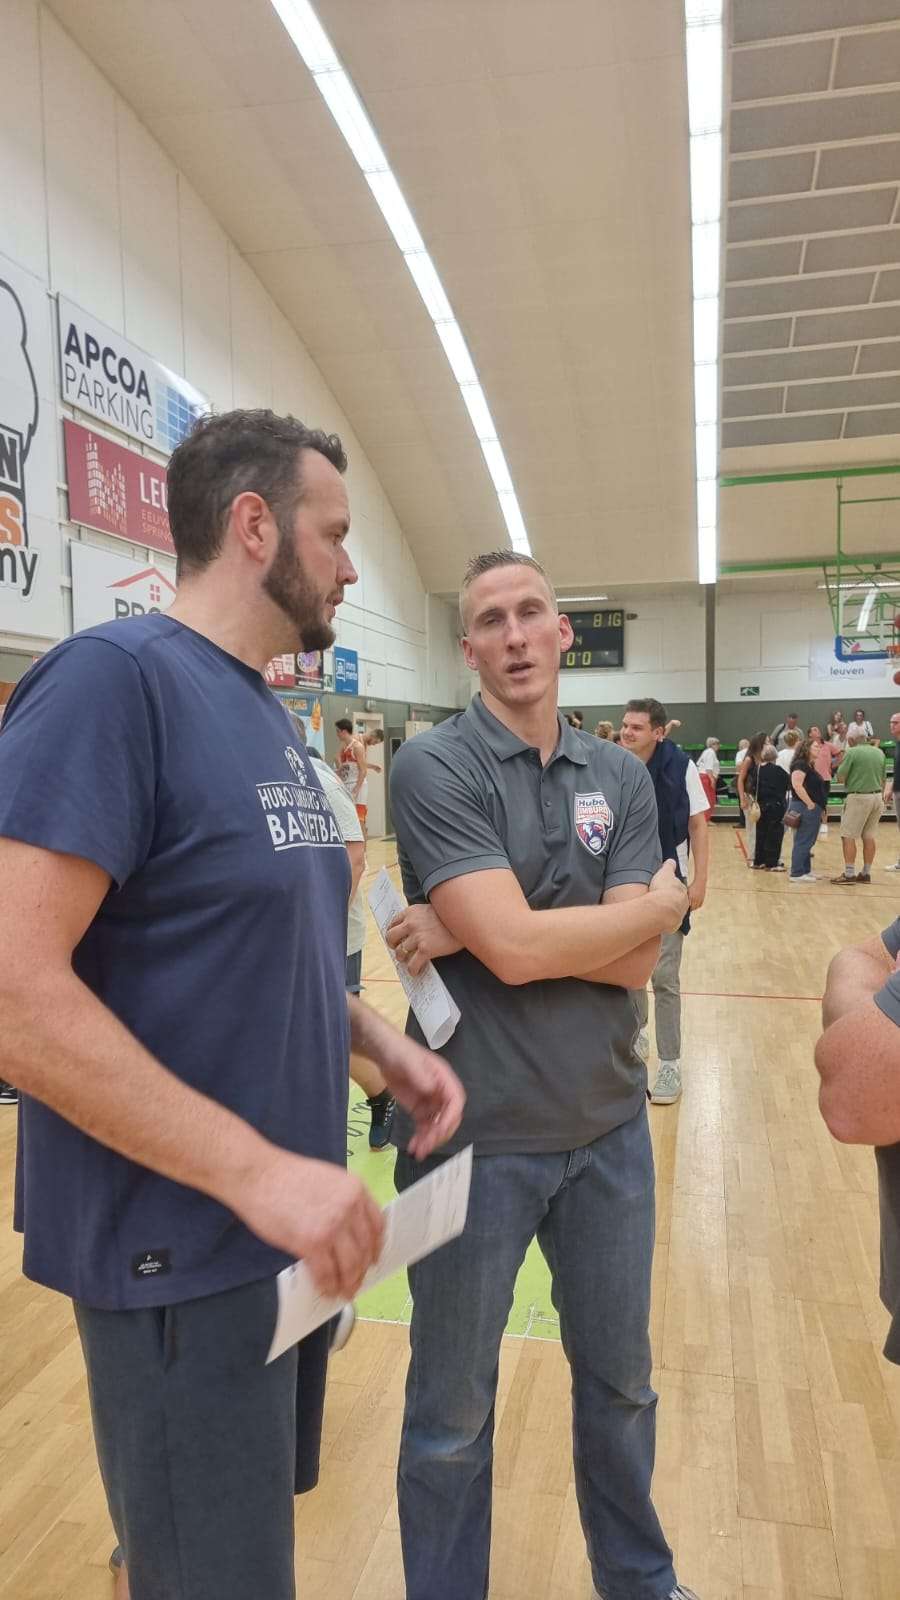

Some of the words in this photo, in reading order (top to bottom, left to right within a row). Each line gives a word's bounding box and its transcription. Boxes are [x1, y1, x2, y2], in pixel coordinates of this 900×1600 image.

[64, 322, 152, 407] APCOA
[65, 362, 153, 439] PARKING
[830, 666, 864, 675] leuven
[257, 786, 294, 810] HUBO
[578, 798, 605, 807] Hubo
